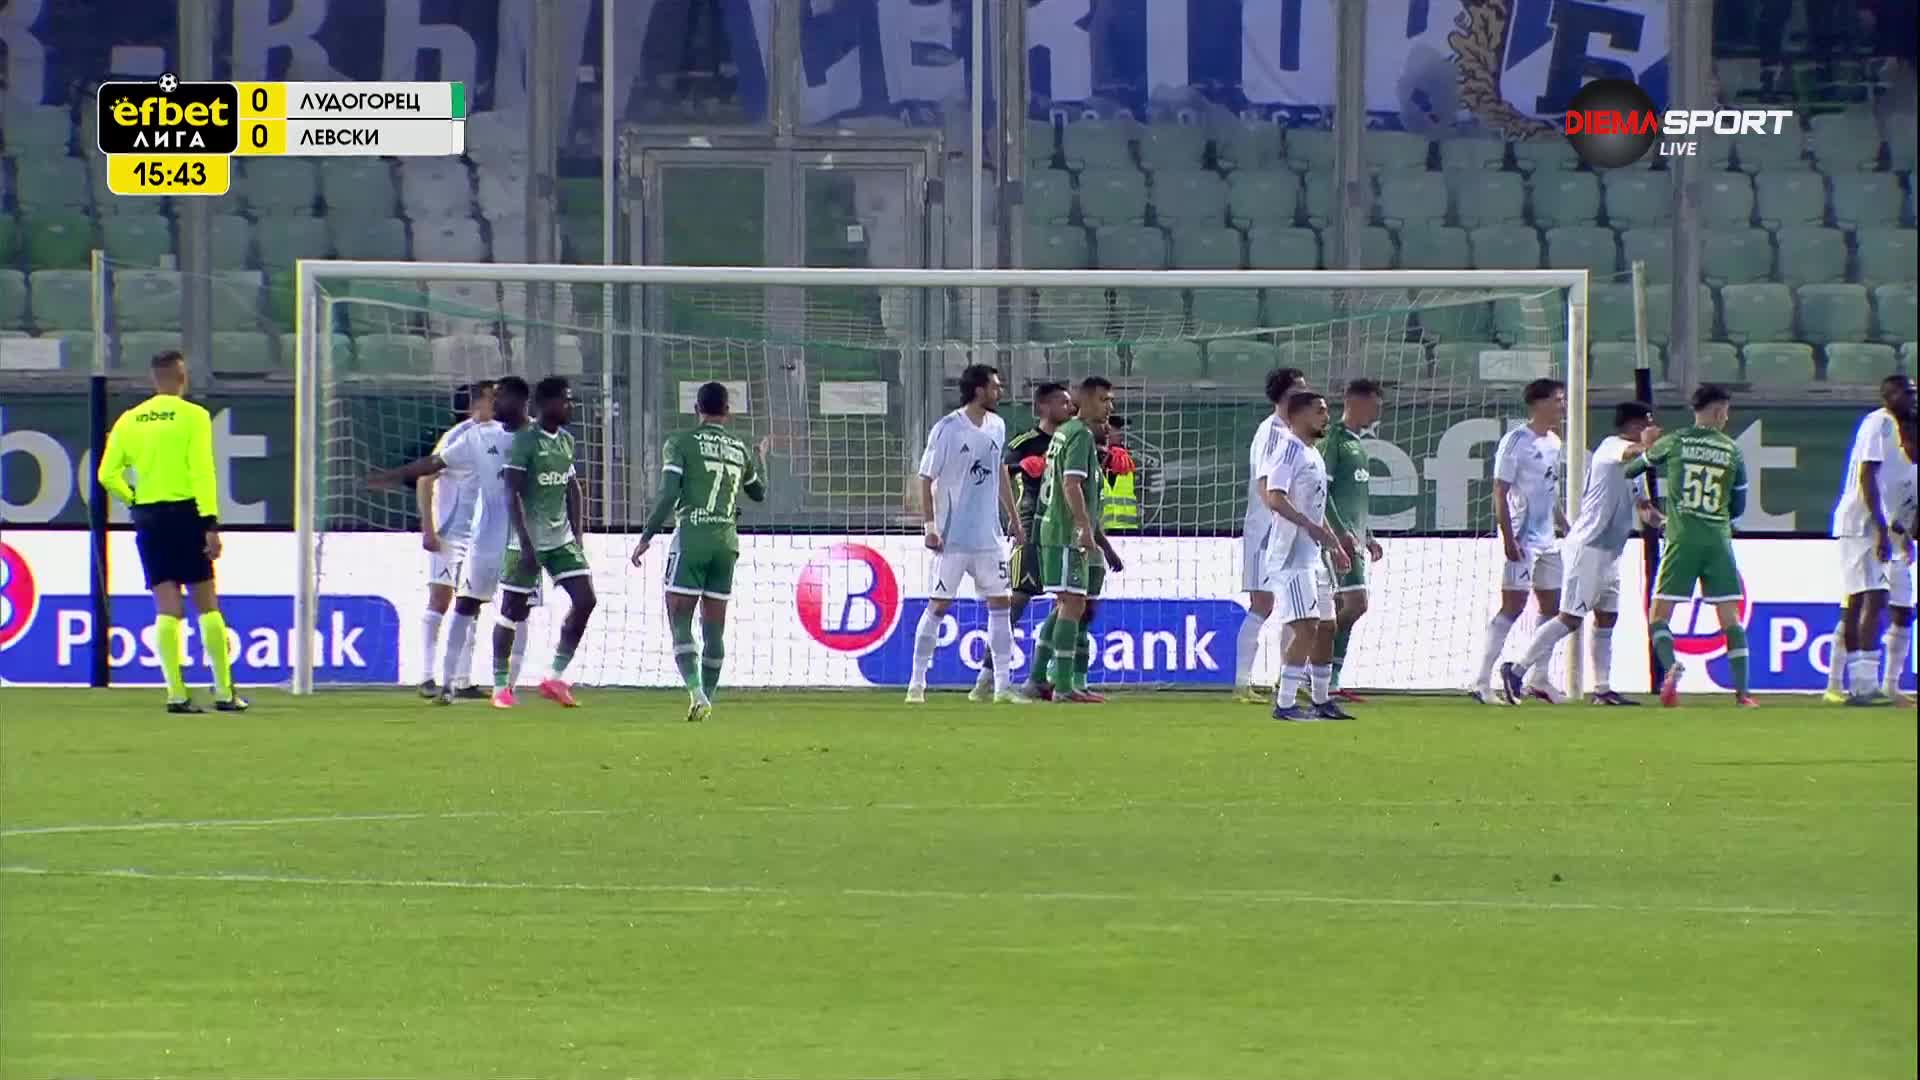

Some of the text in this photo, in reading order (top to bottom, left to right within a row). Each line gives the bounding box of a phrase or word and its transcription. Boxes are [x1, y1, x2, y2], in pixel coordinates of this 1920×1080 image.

[703, 460, 742, 517] 77
[1362, 417, 1798, 531] eft
[1683, 463, 1726, 513] 55
[928, 613, 1220, 672] Poank
